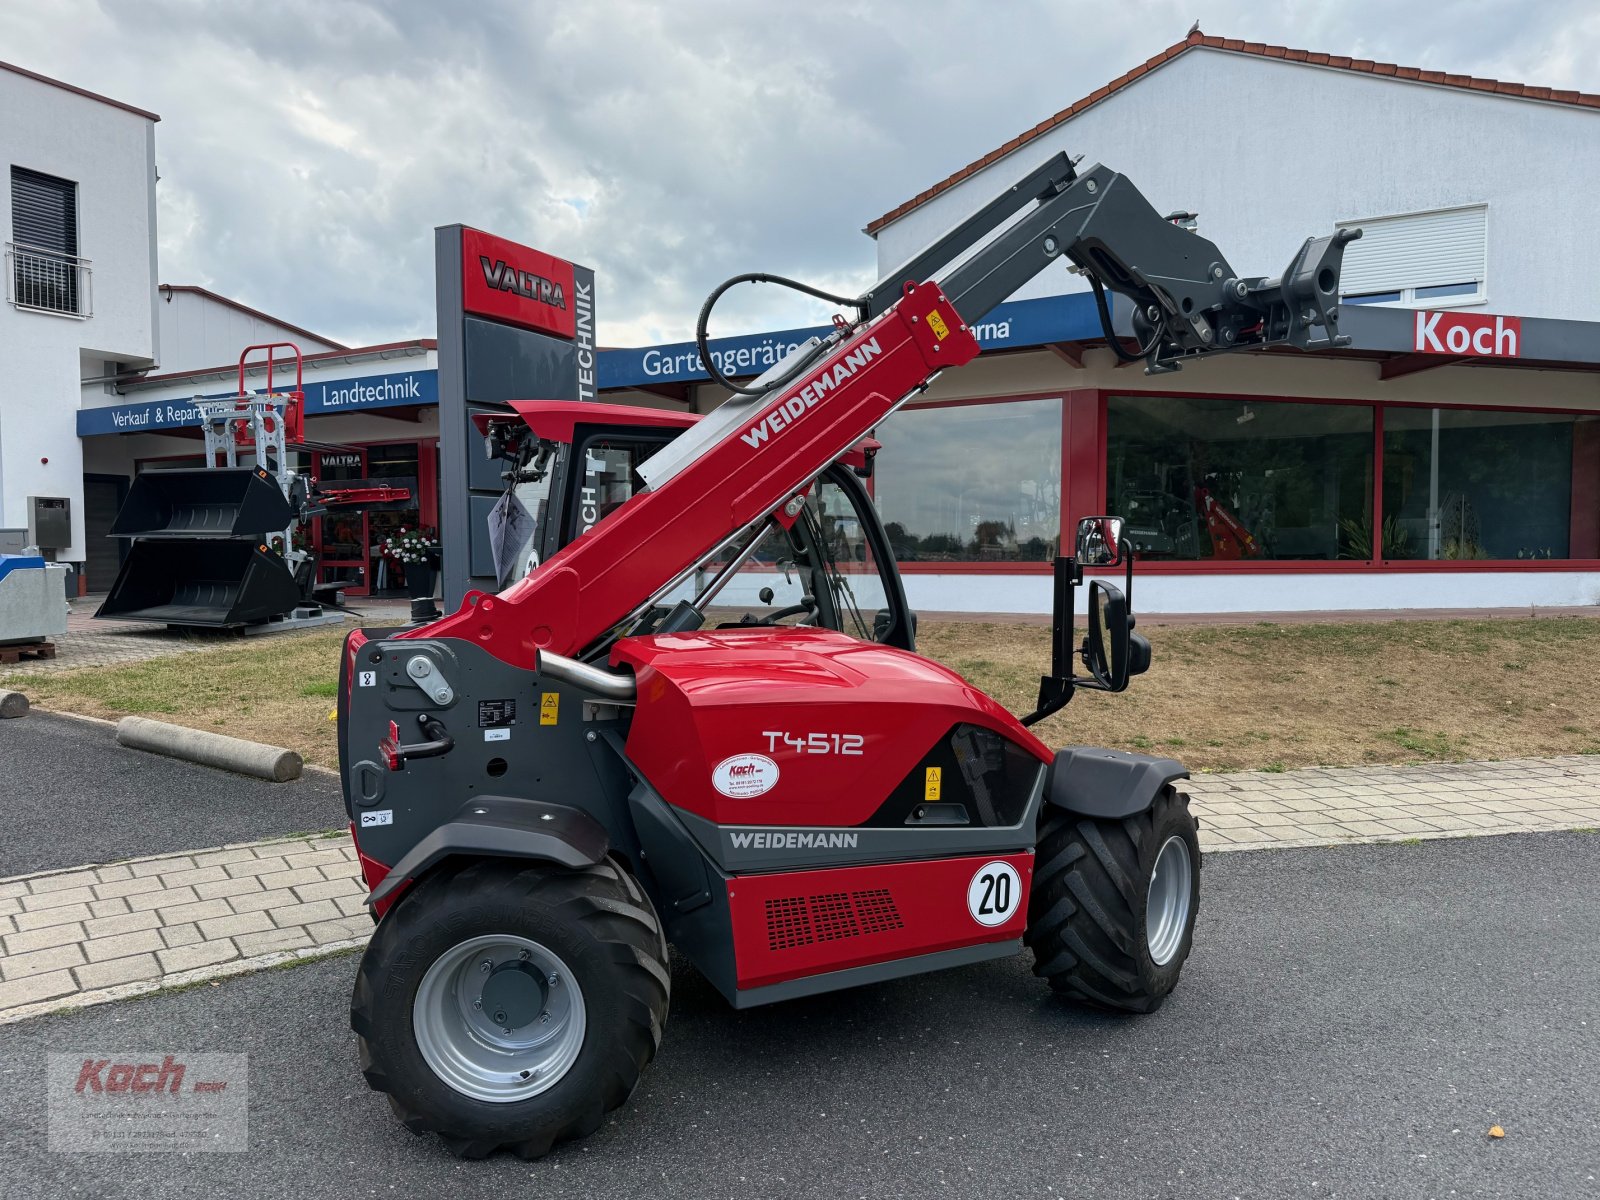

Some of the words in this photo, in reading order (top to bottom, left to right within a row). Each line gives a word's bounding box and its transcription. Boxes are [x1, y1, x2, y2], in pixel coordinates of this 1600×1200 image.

[479, 255, 566, 309] VALTRA
[576, 281, 593, 401] TECHNIK
[1415, 312, 1516, 355] Koch
[322, 375, 421, 406] Landtechnik
[740, 337, 882, 448] WEIDEMANN
[112, 409, 150, 426] Verkauf
[156, 407, 164, 422] &
[321, 455, 361, 467] VALTRA
[762, 732, 864, 755] T4512
[729, 763, 755, 775] Koch
[730, 833, 858, 849] WEIDEMANN
[978, 873, 1011, 915] 20
